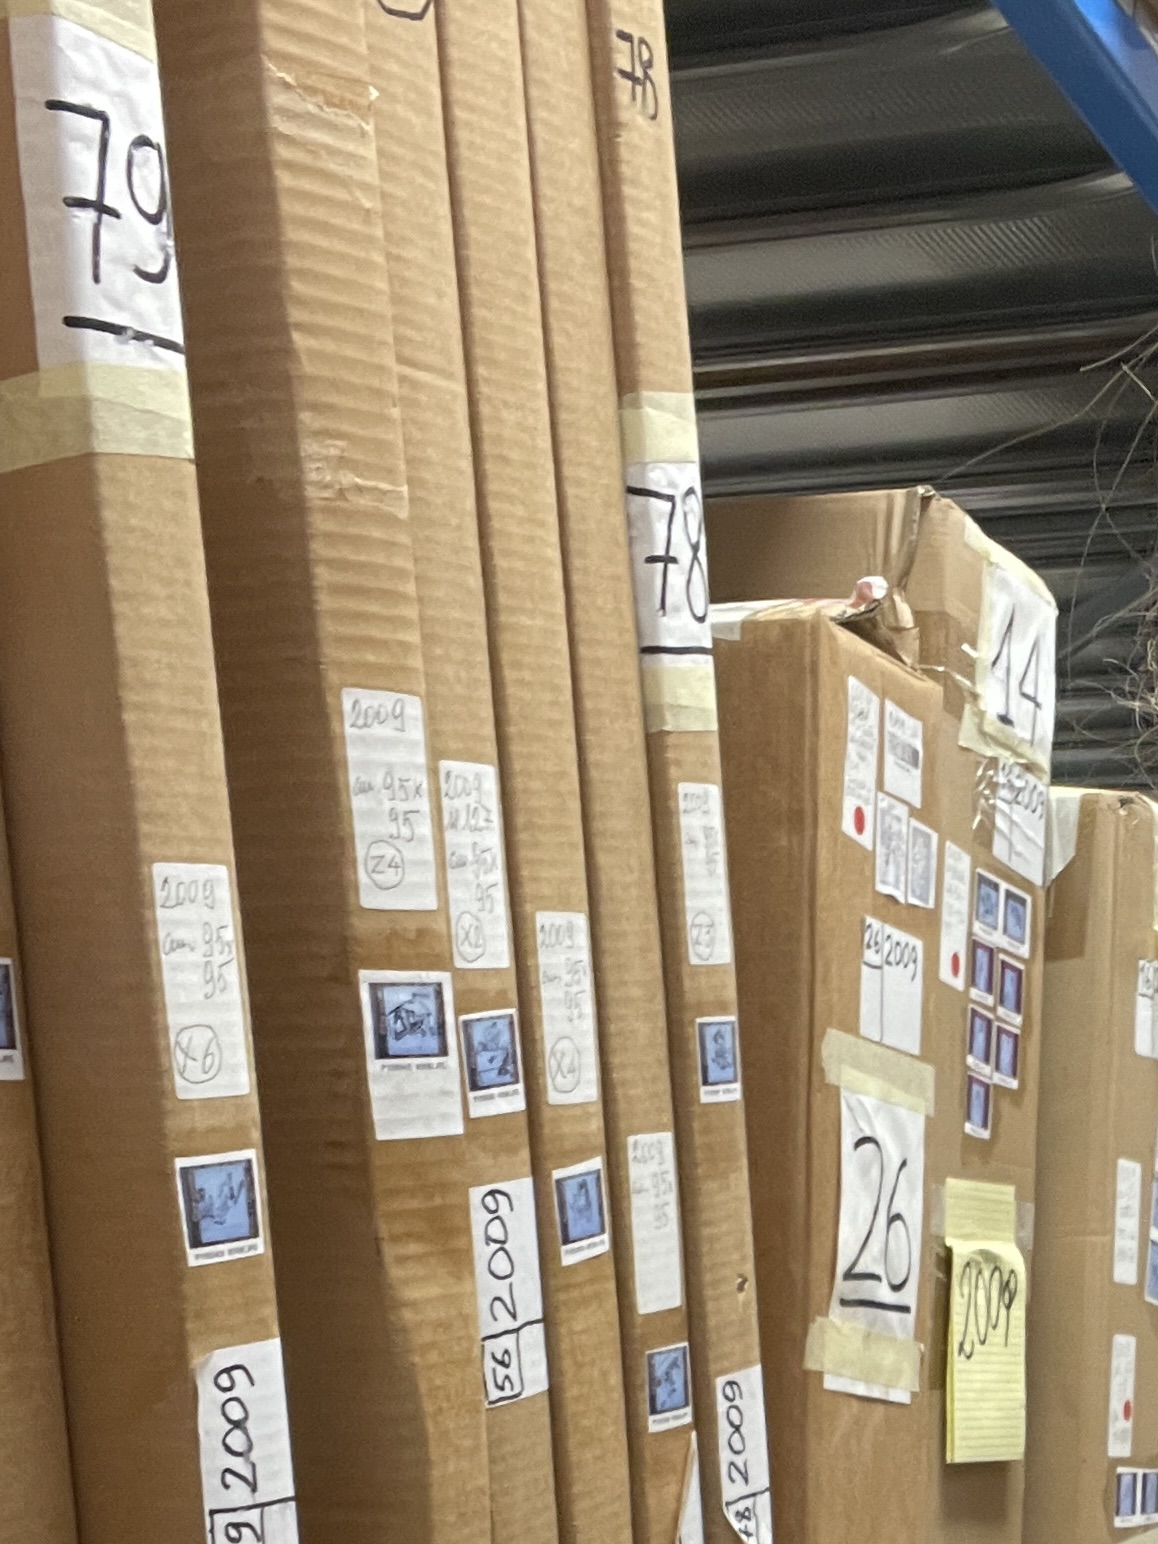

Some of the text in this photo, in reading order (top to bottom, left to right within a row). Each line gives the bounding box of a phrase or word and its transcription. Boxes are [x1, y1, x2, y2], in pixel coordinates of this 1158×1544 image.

[615, 30, 658, 121] 78
[45, 99, 173, 285] 79
[625, 484, 709, 624] 78
[350, 698, 406, 732] 2009
[991, 602, 1042, 747] 14
[160, 876, 216, 910] 2009
[864, 922, 918, 982] 26 2009
[842, 1135, 911, 1292] 26
[481, 1188, 517, 1393] 56 2009
[957, 1260, 1018, 1361] 2009
[213, 1363, 258, 1494] 2009
[722, 1380, 750, 1487] 2009
